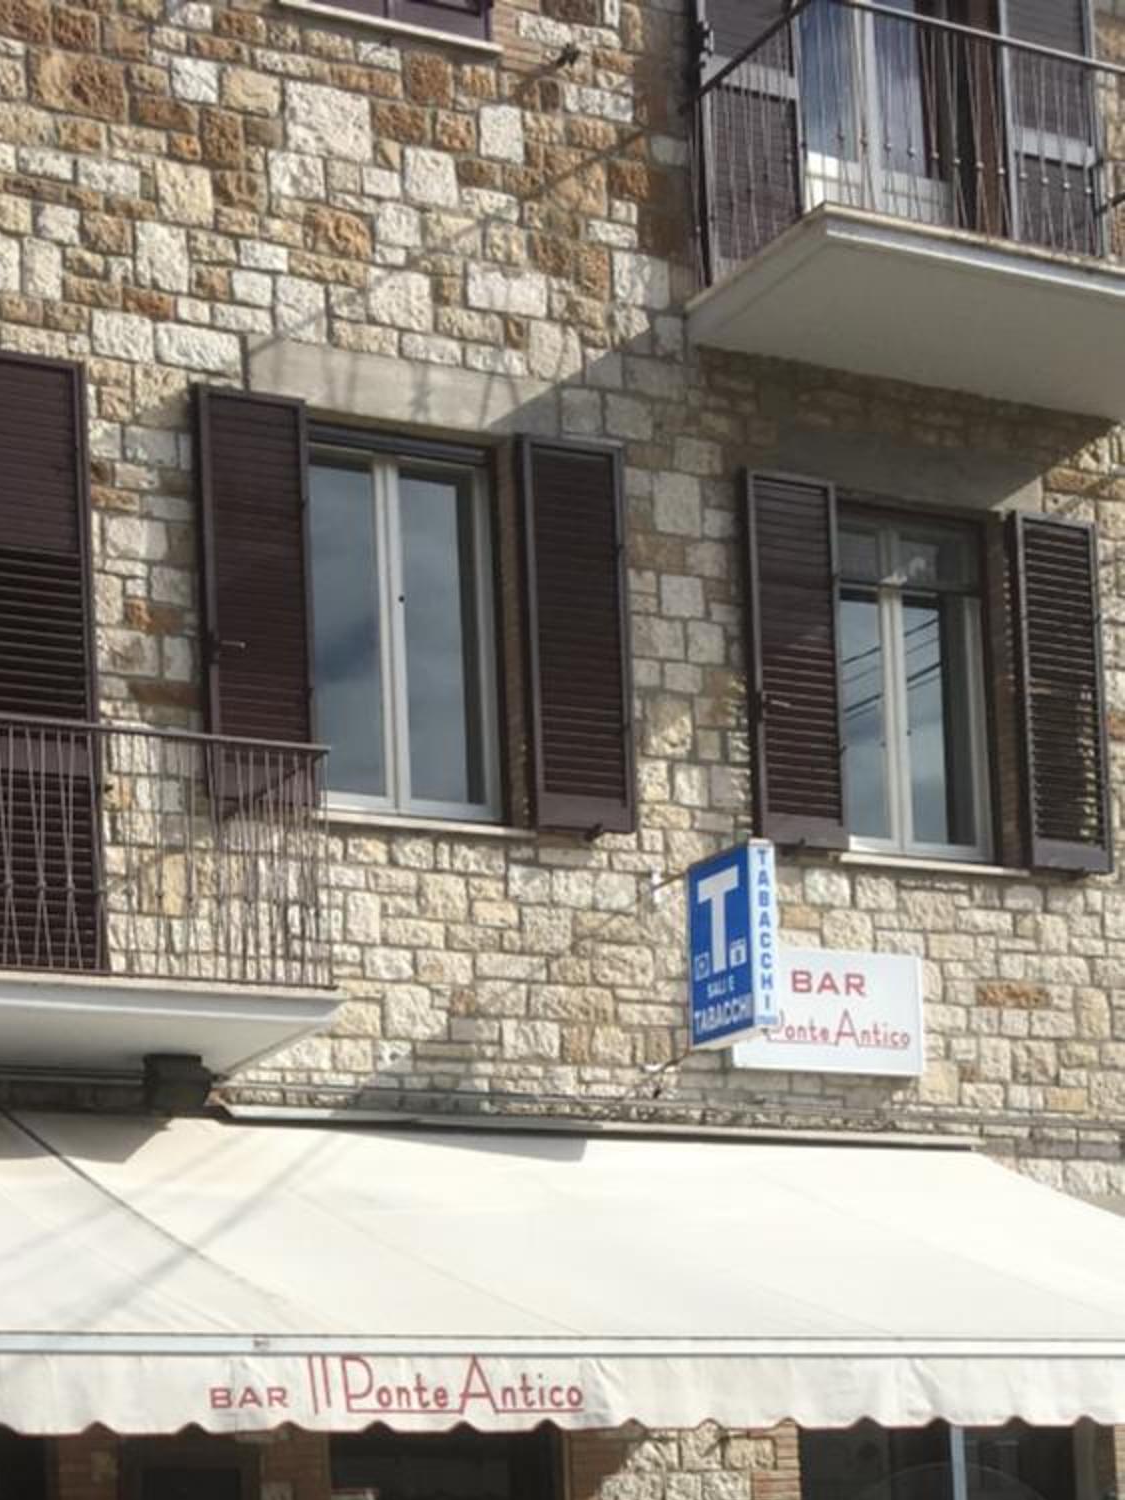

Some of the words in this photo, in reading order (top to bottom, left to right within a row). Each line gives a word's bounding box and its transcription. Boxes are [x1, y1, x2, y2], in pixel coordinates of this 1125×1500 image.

[697, 865, 739, 974] T
[756, 849, 773, 1010] TABACCHI
[791, 969, 866, 997] BAR
[835, 1007, 910, 1049] Antico
[210, 1386, 289, 1409] BAR
[341, 1354, 450, 1413] Ponte
[457, 1354, 585, 1414] Antico
